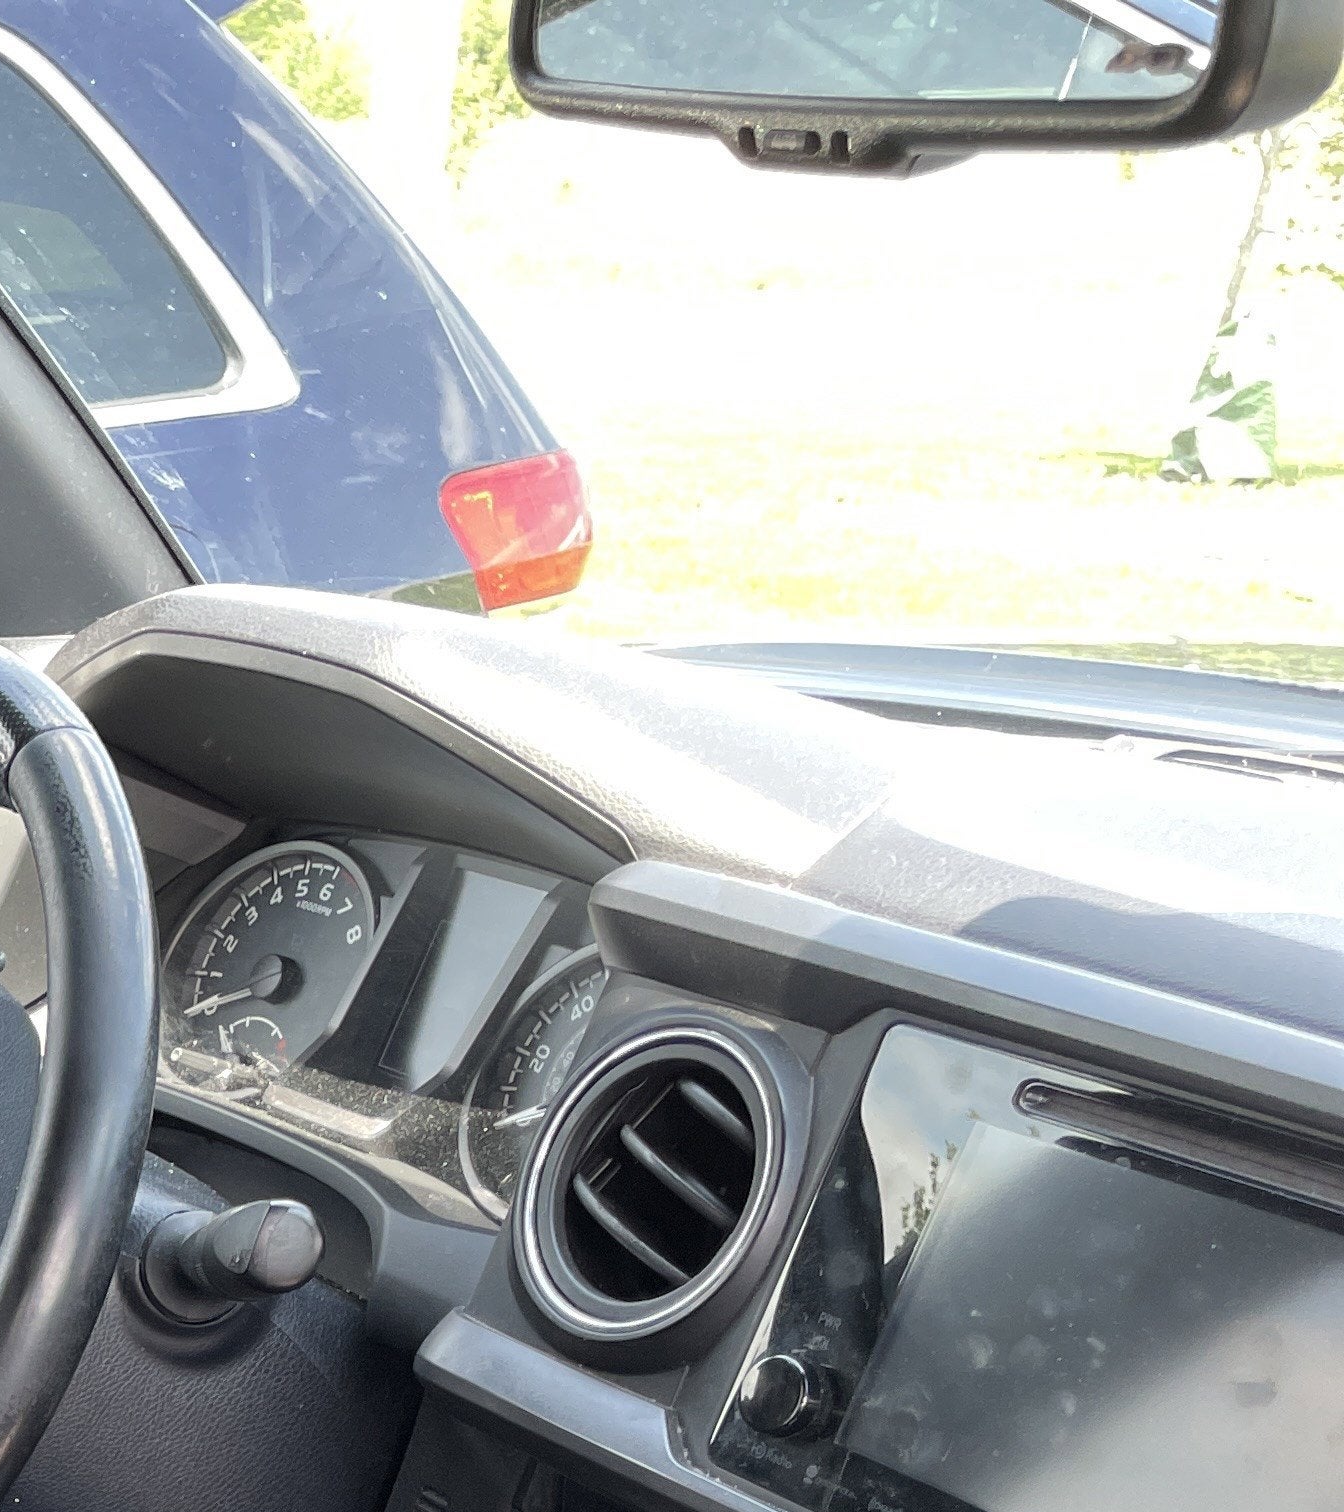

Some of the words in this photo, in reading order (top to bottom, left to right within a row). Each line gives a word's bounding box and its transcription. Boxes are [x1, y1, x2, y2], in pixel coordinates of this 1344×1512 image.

[269, 886, 284, 906] 4
[295, 879, 310, 898] 5
[319, 882, 335, 902] 6
[336, 896, 354, 915] 7
[244, 907, 259, 927] 3
[222, 933, 239, 953] 2
[346, 925, 363, 945] 8
[570, 994, 595, 1022] 40
[528, 1043, 552, 1074] 20
